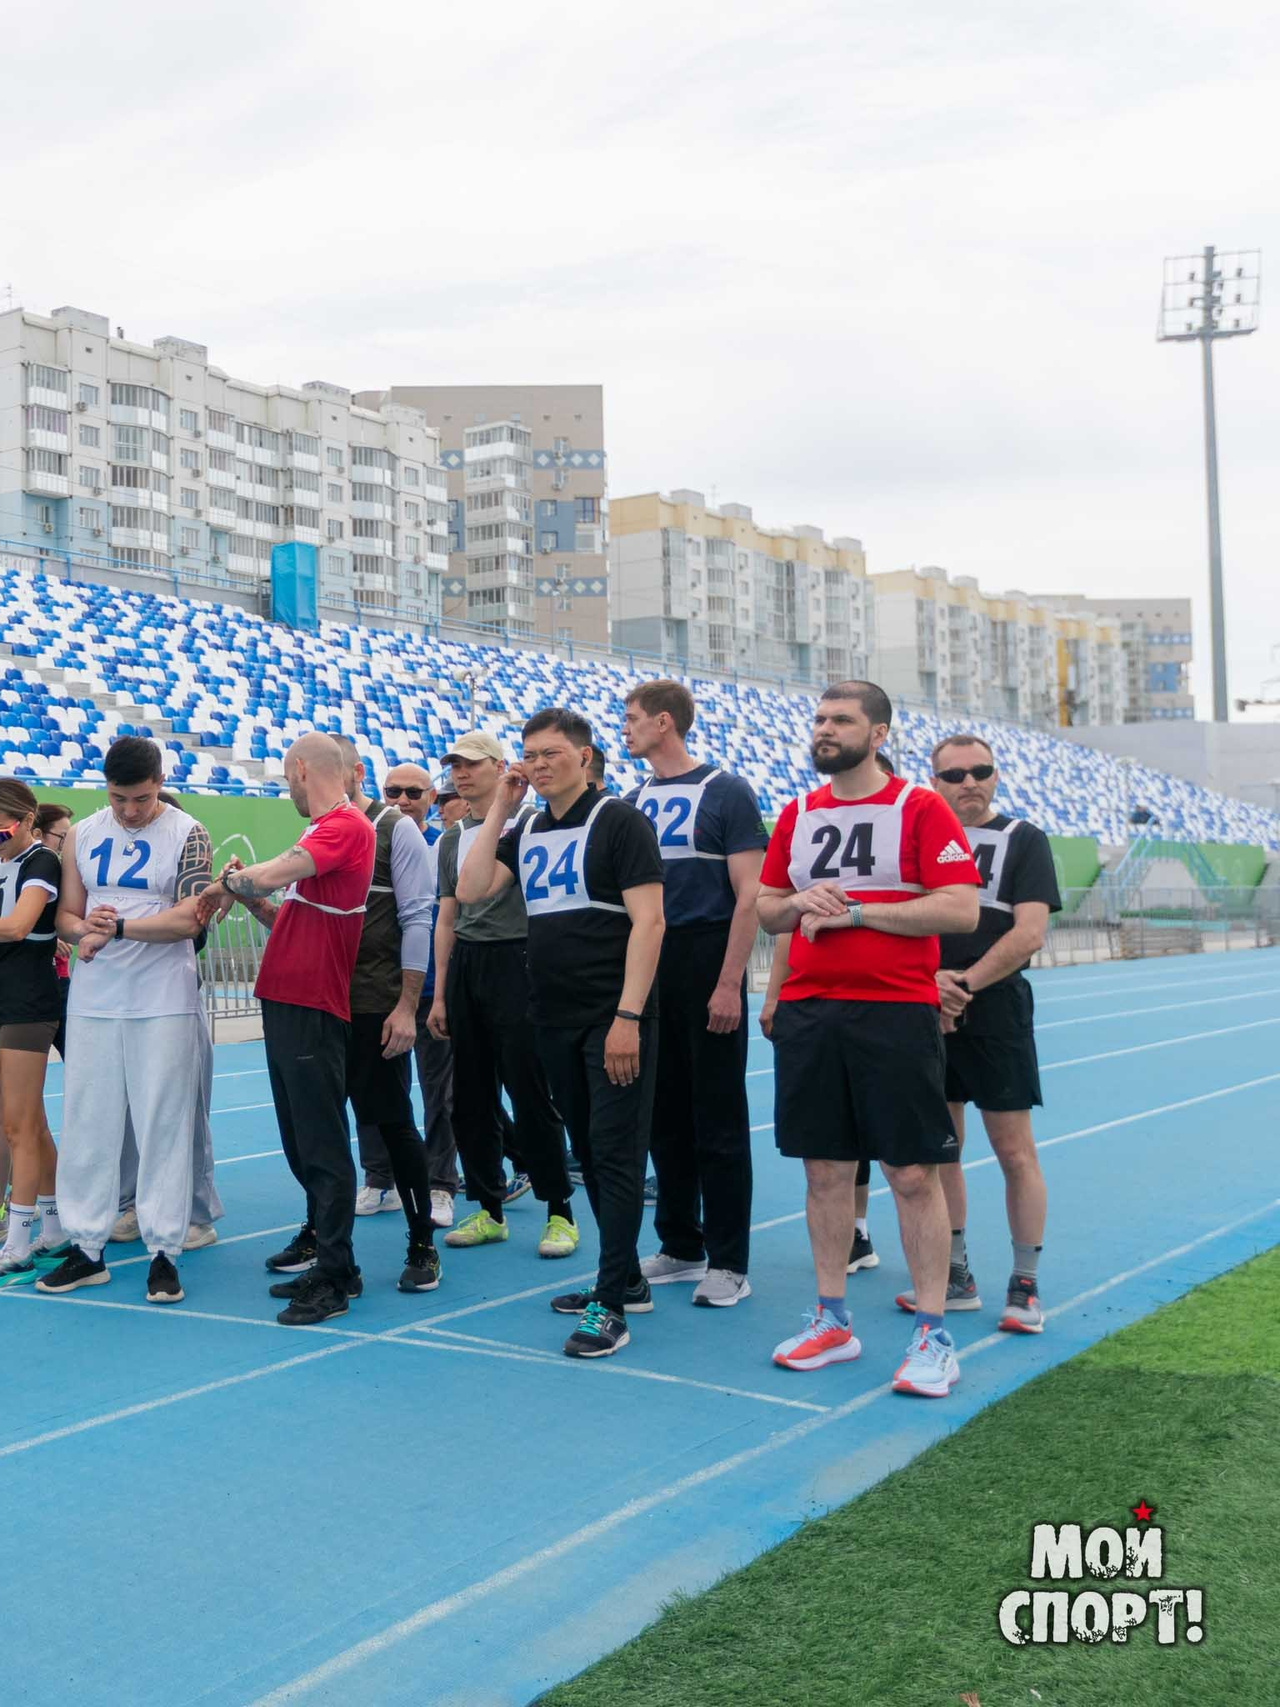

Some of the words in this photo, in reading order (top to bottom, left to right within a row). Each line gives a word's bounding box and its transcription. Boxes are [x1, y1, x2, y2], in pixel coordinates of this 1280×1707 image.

[90, 837, 149, 890] 12
[523, 840, 579, 901] 24
[810, 822, 875, 879] 24
[936, 852, 972, 864] adidas
